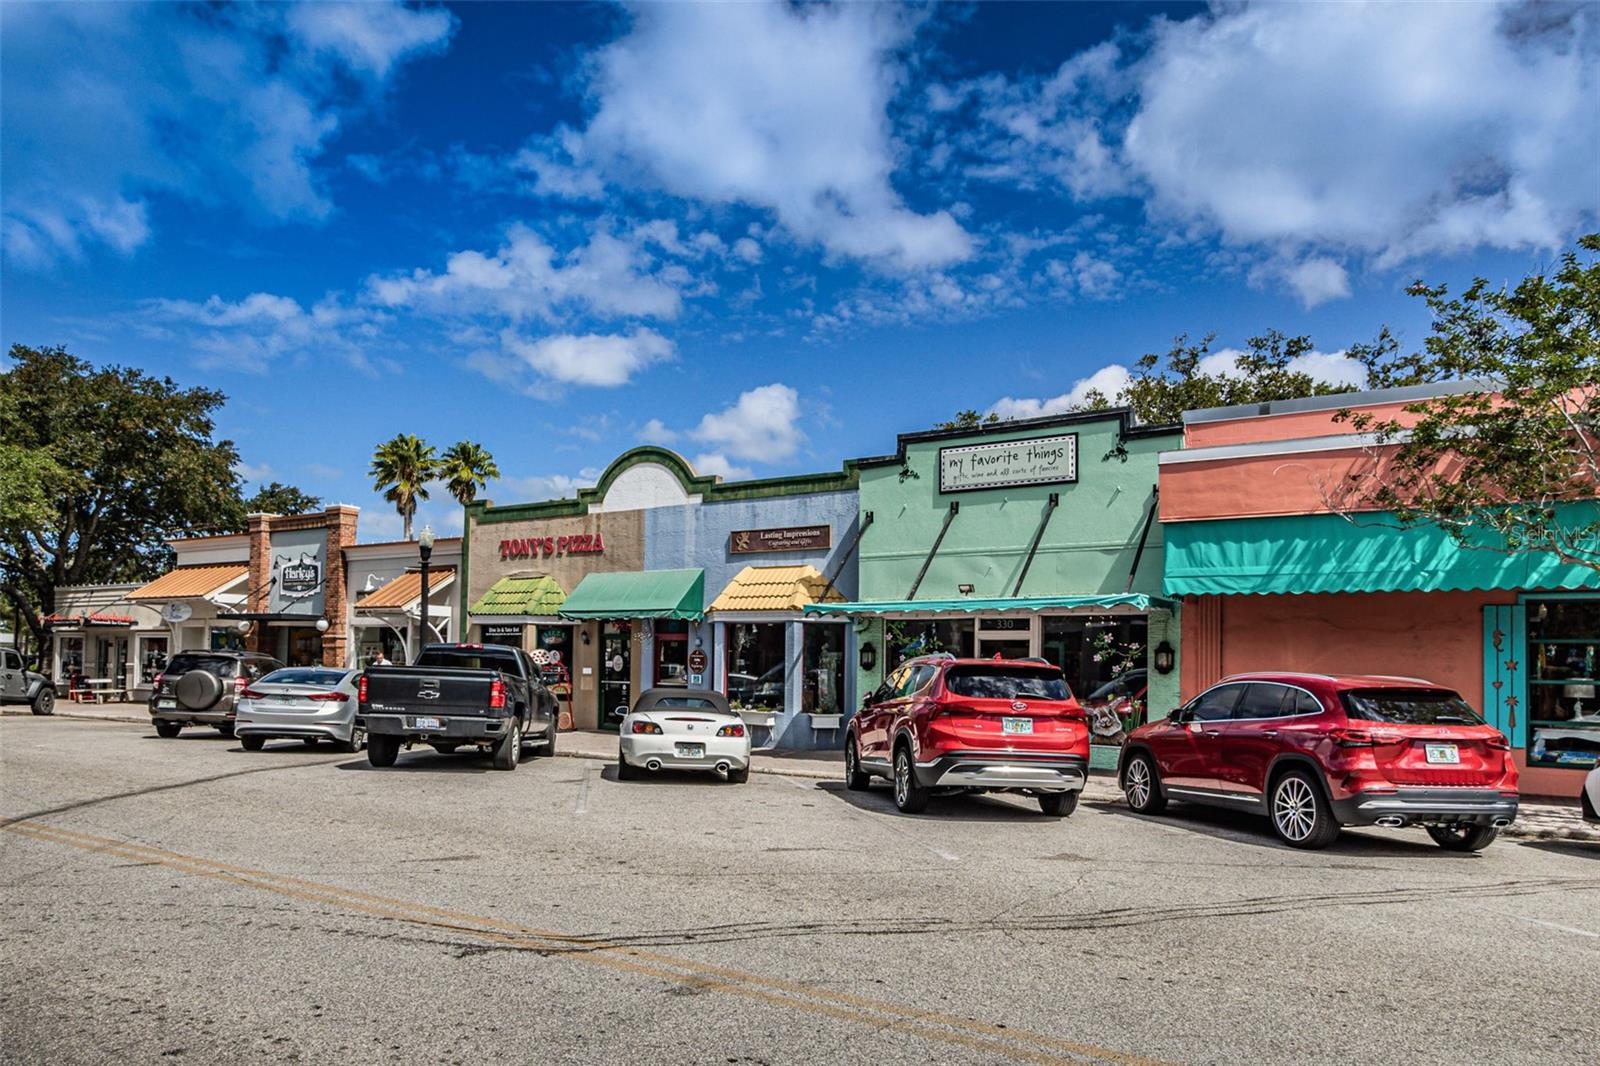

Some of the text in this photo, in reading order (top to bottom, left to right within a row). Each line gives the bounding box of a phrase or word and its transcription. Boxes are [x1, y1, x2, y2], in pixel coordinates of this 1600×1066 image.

[949, 445, 1064, 474] my favorite things
[986, 469, 998, 478] and
[1000, 467, 1010, 477] all
[1029, 464, 1037, 476] of
[760, 528, 821, 541] Lasting Impressions
[500, 533, 605, 557] TONY'S PIZZA
[996, 620, 1014, 629] 330
